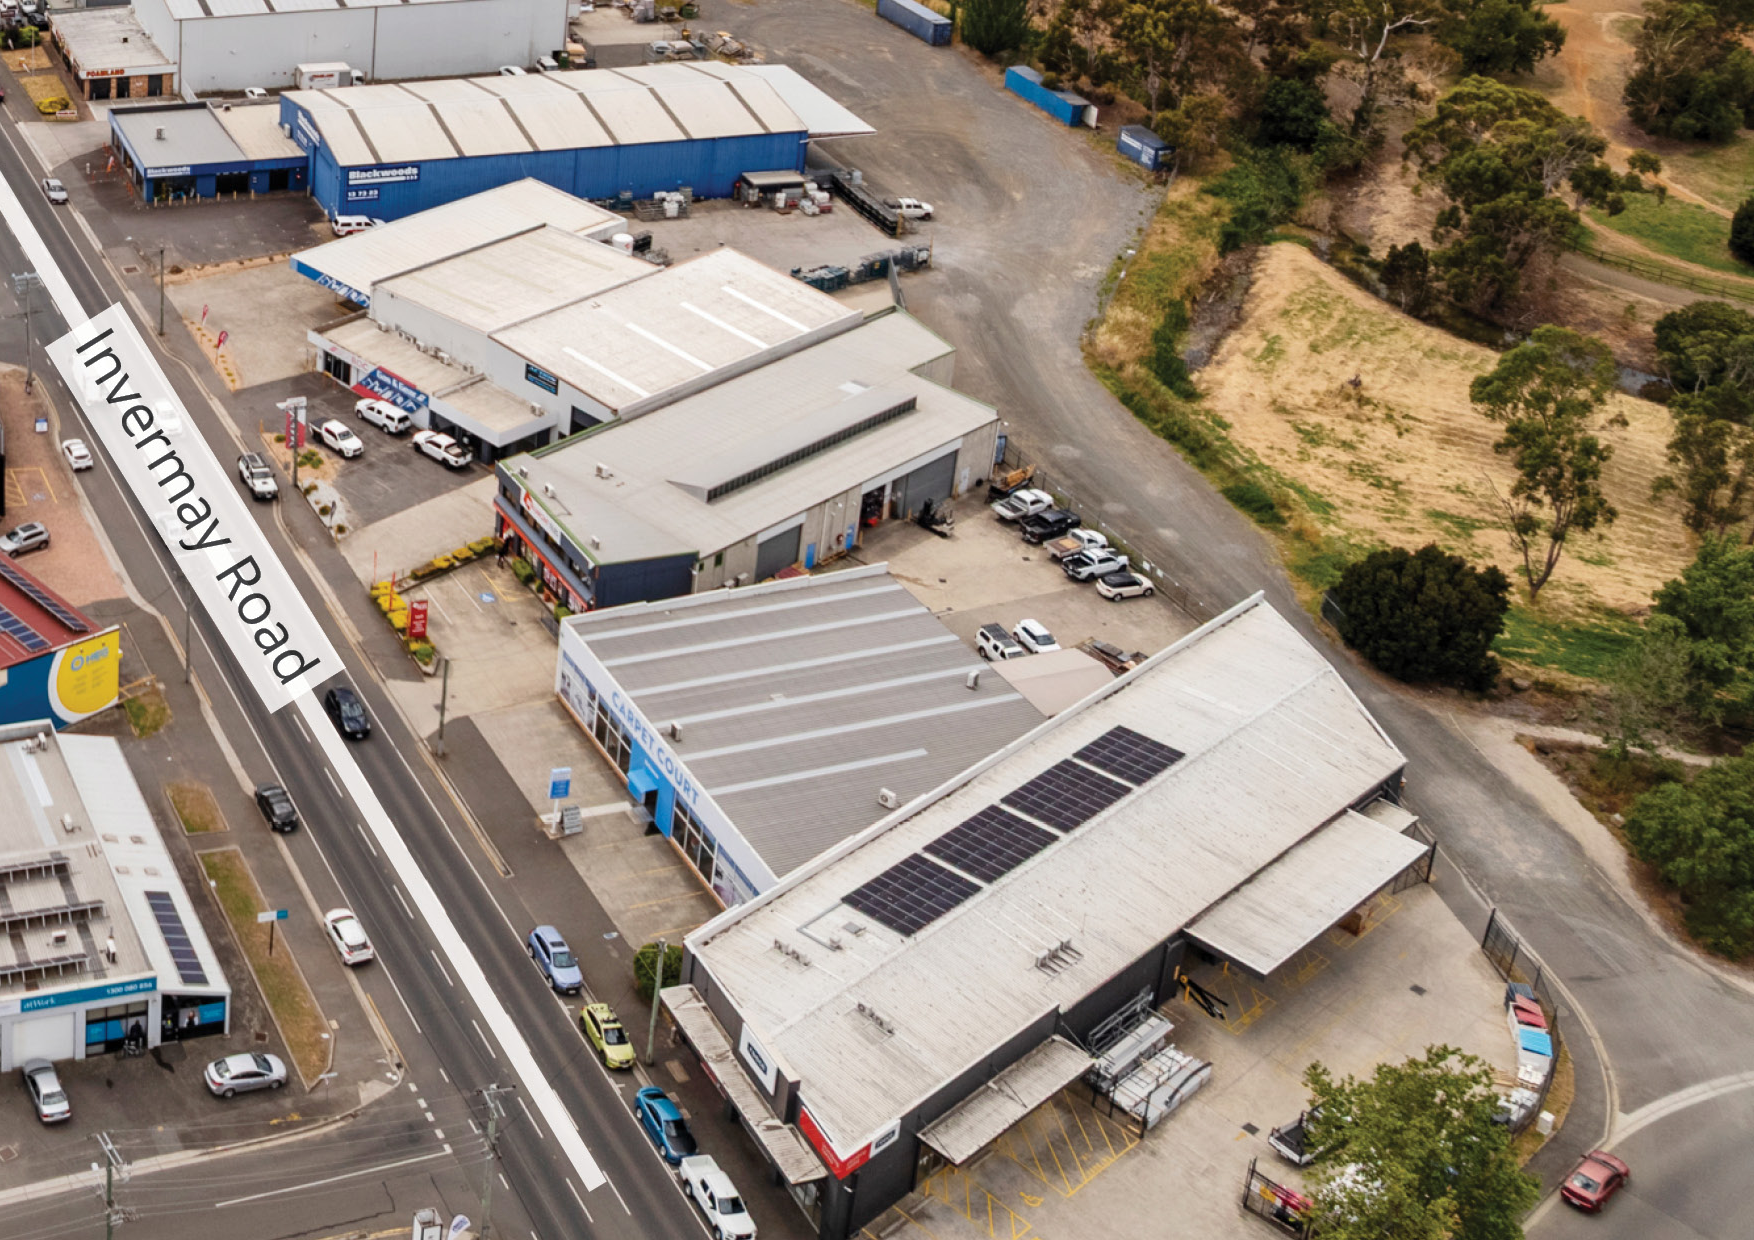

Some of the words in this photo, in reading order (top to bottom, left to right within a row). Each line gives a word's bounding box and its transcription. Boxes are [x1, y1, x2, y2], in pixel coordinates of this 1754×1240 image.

[147, 165, 191, 176] Blackwoods
[348, 166, 418, 180] Blackwoods
[611, 690, 655, 749] CARPET
[657, 747, 700, 805] COURT
